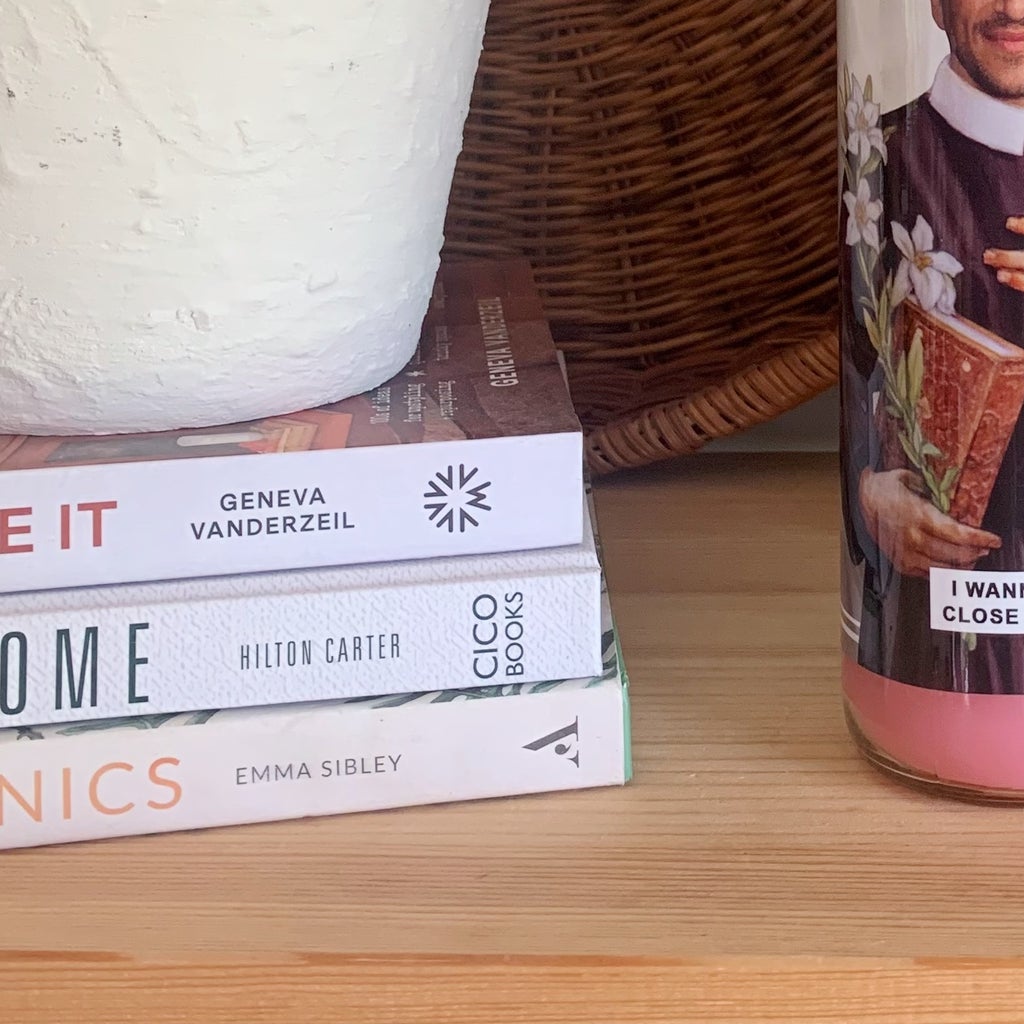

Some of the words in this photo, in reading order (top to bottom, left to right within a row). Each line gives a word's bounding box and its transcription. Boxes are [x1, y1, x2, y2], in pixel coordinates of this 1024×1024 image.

[485, 347, 519, 387] GENEVA
[220, 487, 326, 511] GENEVA
[60, 500, 118, 549] IT
[191, 511, 355, 540] VANDERZEIL
[951, 580, 957, 596] I
[942, 605, 1019, 624] CLOSE
[472, 593, 498, 679] CICO
[504, 591, 524, 677] BOOKS
[240, 640, 312, 670] HILTON
[325, 633, 400, 664] CARTER
[236, 761, 312, 785] EMMA
[321, 754, 402, 777] SIBLEY
